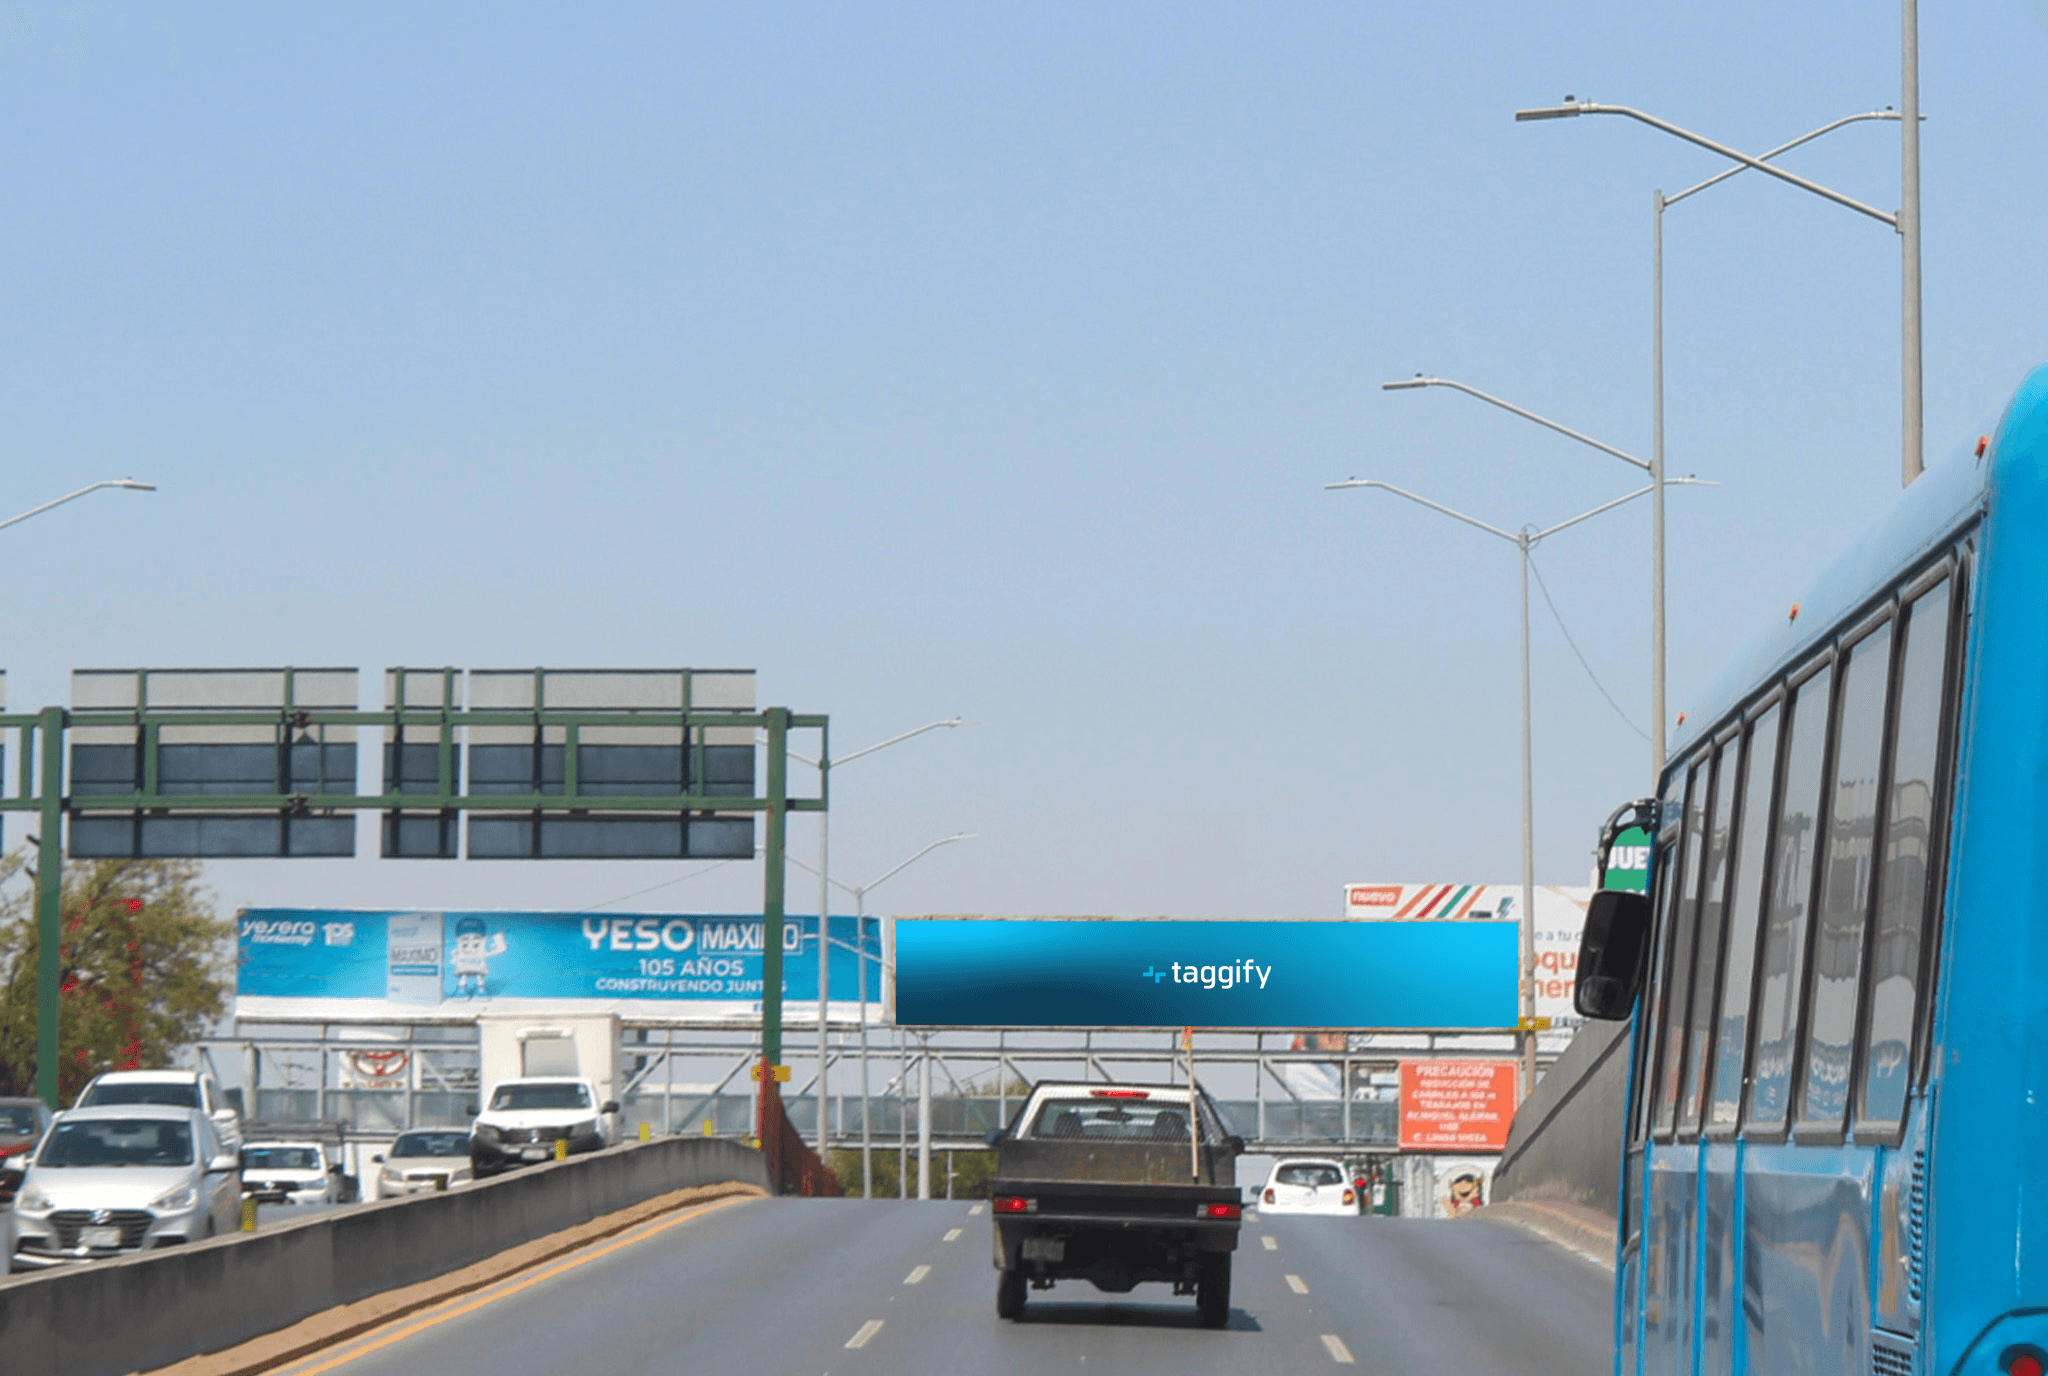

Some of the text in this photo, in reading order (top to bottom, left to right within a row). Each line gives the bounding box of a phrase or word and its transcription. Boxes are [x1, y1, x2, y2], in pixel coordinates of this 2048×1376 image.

[582, 918, 799, 951] YESO MAXIO
[639, 956, 745, 977] 105 AÑOS
[1171, 959, 1272, 989] taggify
[595, 978, 787, 993] CONSTRUYENDO JUNTS
